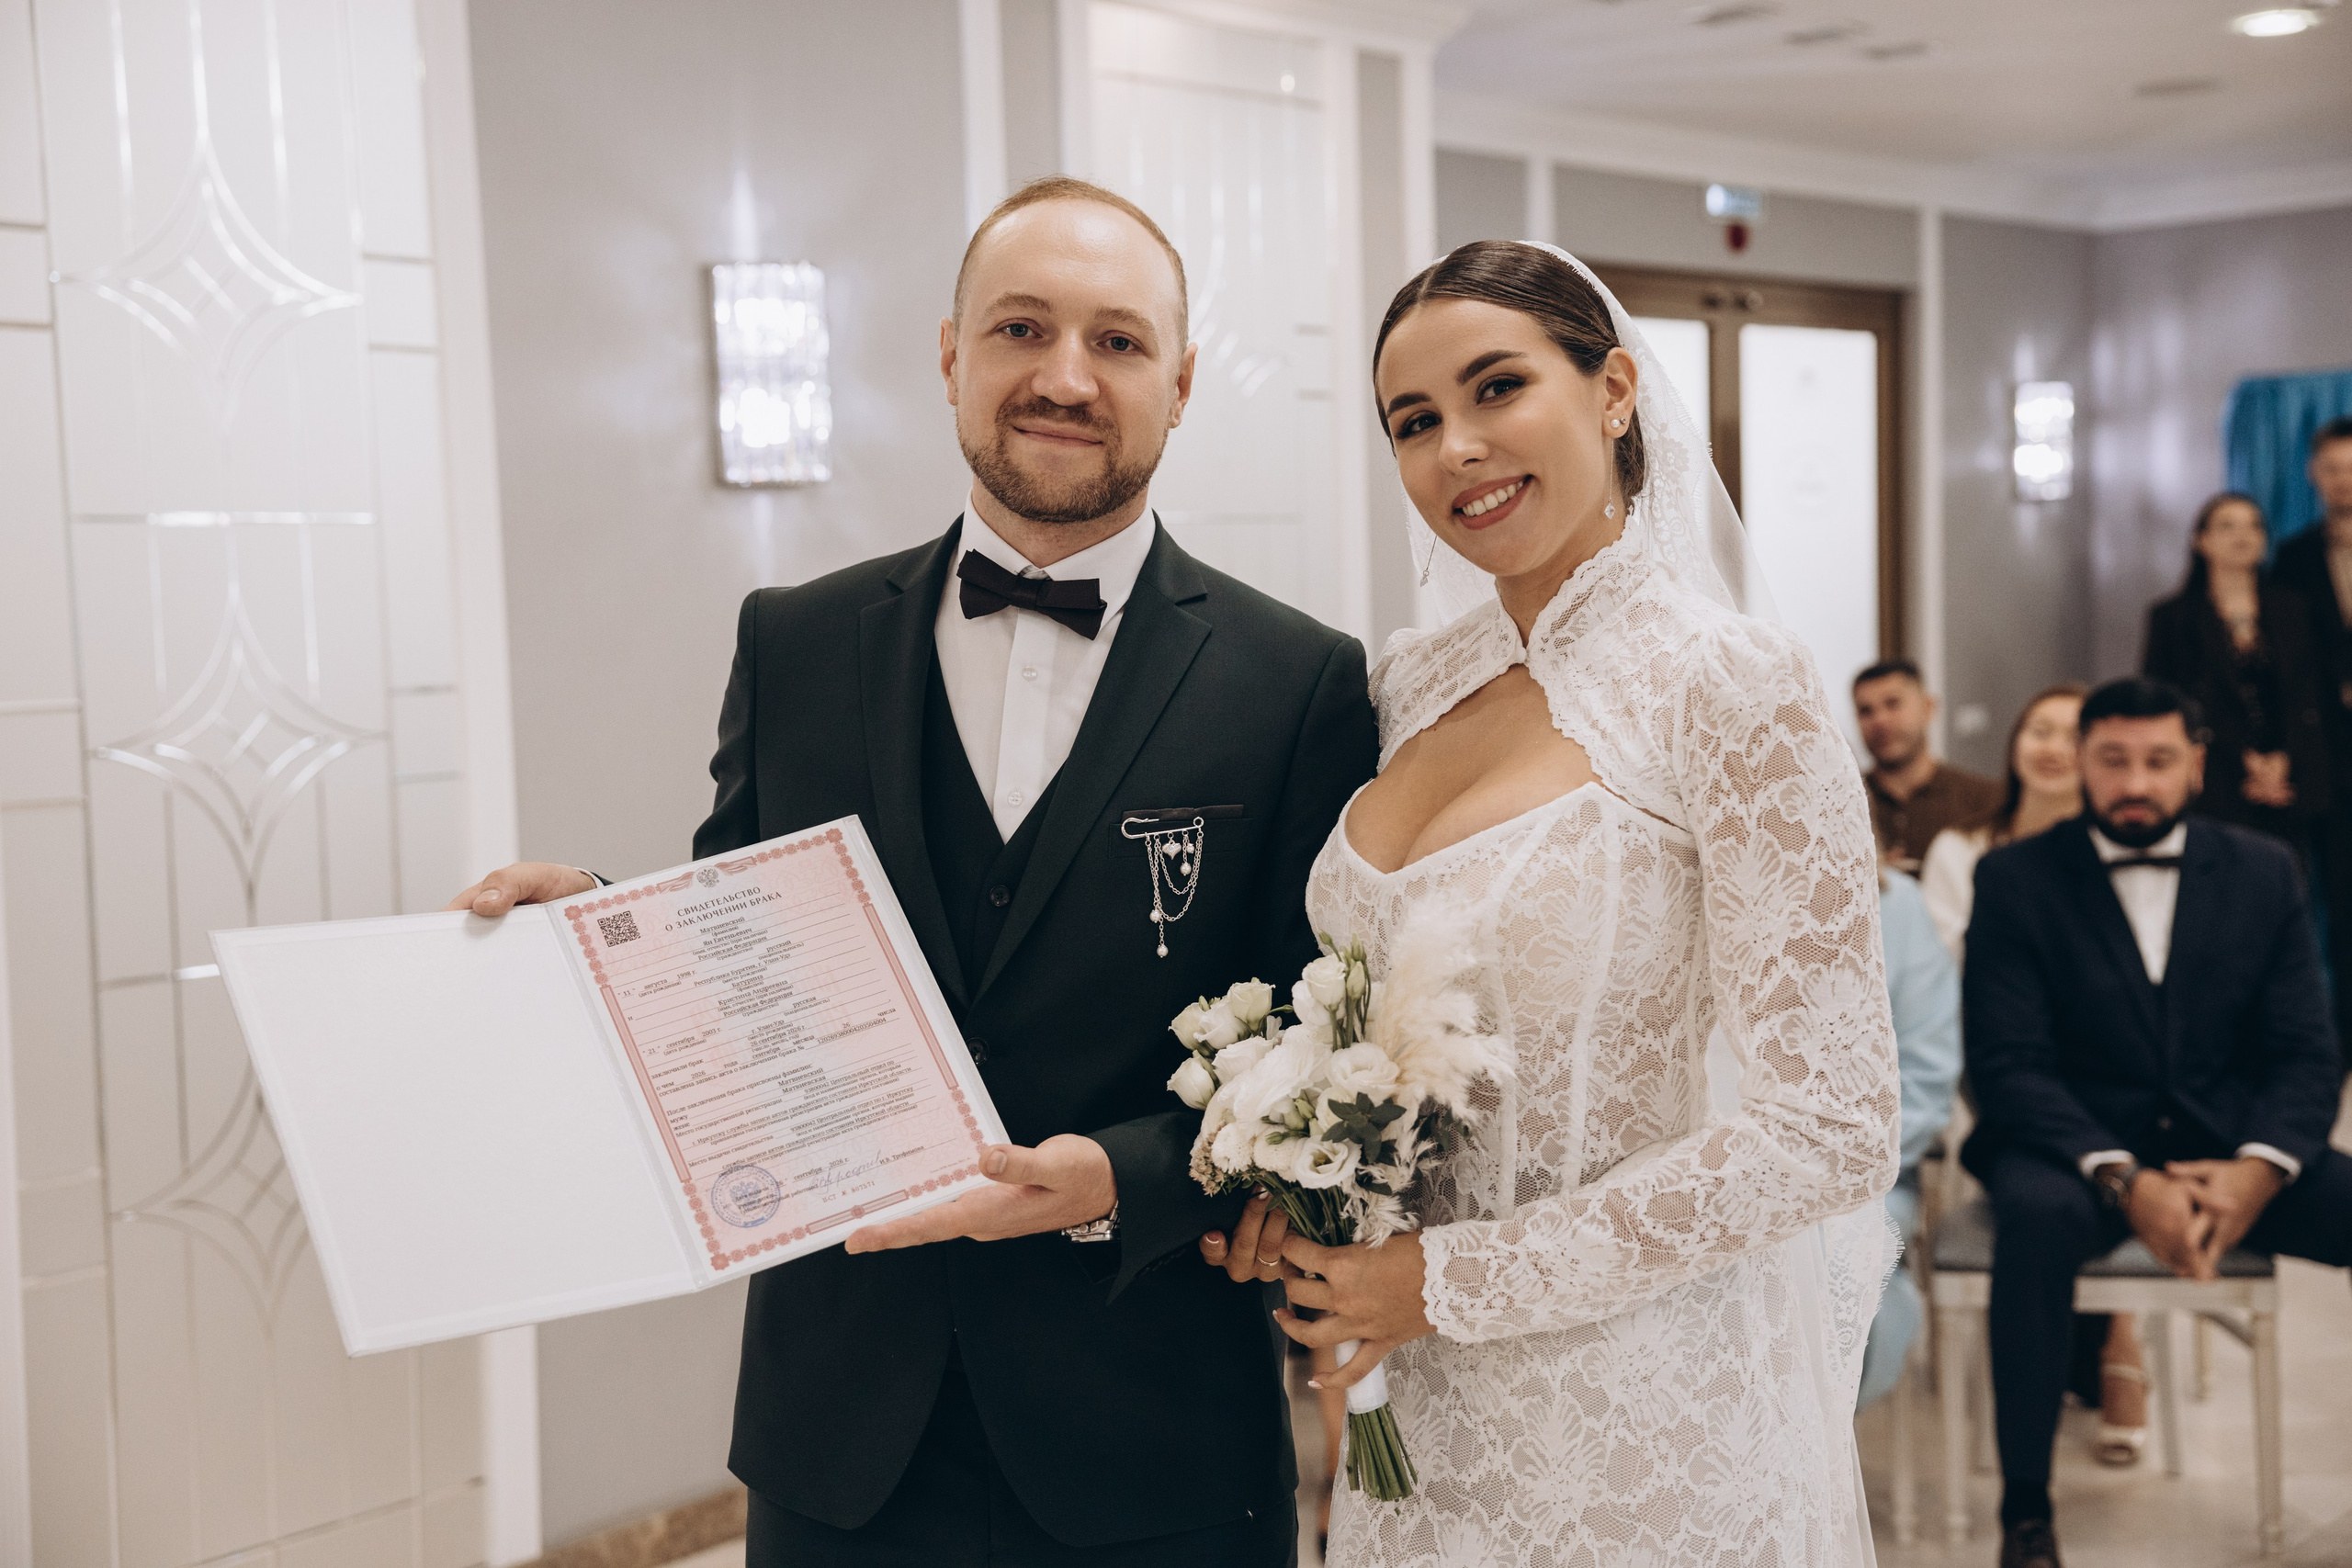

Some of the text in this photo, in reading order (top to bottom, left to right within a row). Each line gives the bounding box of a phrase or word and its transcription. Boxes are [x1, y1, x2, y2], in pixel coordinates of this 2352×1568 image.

[664, 890, 782, 931] О ЗАКЛЮЧЕНИИ БРАКА
[676, 886, 761, 917] СВИДЕТЕЛЬСТВО
[699, 916, 745, 933] Матвиевский
[713, 927, 752, 943] Евгеньевич
[643, 978, 668, 989] августа
[765, 940, 792, 952] русский
[694, 971, 730, 987] Республика
[729, 963, 757, 976] Бурятия,
[763, 953, 790, 964] Улан-Удэ
[697, 935, 767, 961] Российская Федерация
[718, 979, 788, 1006] Кристина Андреевна
[731, 974, 763, 987] Батурина
[665, 1034, 695, 1048] сентября
[701, 1028, 716, 1036] 2003
[791, 996, 817, 1008] русская
[723, 990, 793, 1017] Российская Федерация
[757, 1019, 785, 1032] Улан-Удэ
[650, 1063, 687, 1079] заключили
[687, 1058, 704, 1067] брак
[757, 1031, 786, 1044] сентября
[786, 1025, 801, 1034] 2026
[690, 1070, 706, 1078] 2026
[723, 1060, 738, 1068] года
[752, 1045, 780, 1059] сентября
[792, 1034, 815, 1045] месяца
[876, 1008, 896, 1017] числа
[658, 1081, 695, 1097] составлена
[695, 1073, 718, 1085] запись
[718, 1068, 733, 1077] акта
[738, 1054, 777, 1070] заключении
[777, 1047, 797, 1057] брака
[666, 1063, 813, 1116] После заключения брака присвоены фамилии:
[670, 1067, 823, 1123] мужу Матвиевский
[673, 1075, 826, 1131] жене Матвиевская
[675, 1127, 695, 1138] Место
[694, 1110, 744, 1132] государственной
[744, 1098, 782, 1114] регистрации
[830, 1067, 869, 1085] Центральный
[869, 1062, 886, 1071] отдел
[696, 1130, 725, 1144] Иркутску
[725, 1122, 749, 1134] службы
[749, 1114, 771, 1126] записи
[770, 1109, 788, 1119] актов
[787, 1095, 828, 1112] гражданского
[828, 1085, 859, 1100] состояния
[857, 1075, 888, 1089] Иркутской
[888, 1066, 911, 1078] области
[687, 1156, 707, 1168] Место
[730, 1134, 774, 1153] свидетельства
[816, 1106, 856, 1123] Центральный
[856, 1100, 873, 1110] отдел
[887, 1086, 913, 1100] Иркутску
[721, 1157, 746, 1169] службы
[745, 1150, 767, 1161] записи
[766, 1144, 785, 1154] актов
[784, 1129, 828, 1148] гражданского
[828, 1120, 855, 1133] состояния
[854, 1109, 886, 1123] Иркутской
[886, 1100, 910, 1112] области
[793, 1166, 822, 1180] сентября
[829, 1158, 844, 1168] 2026
[891, 1145, 924, 1160] Трофимова
